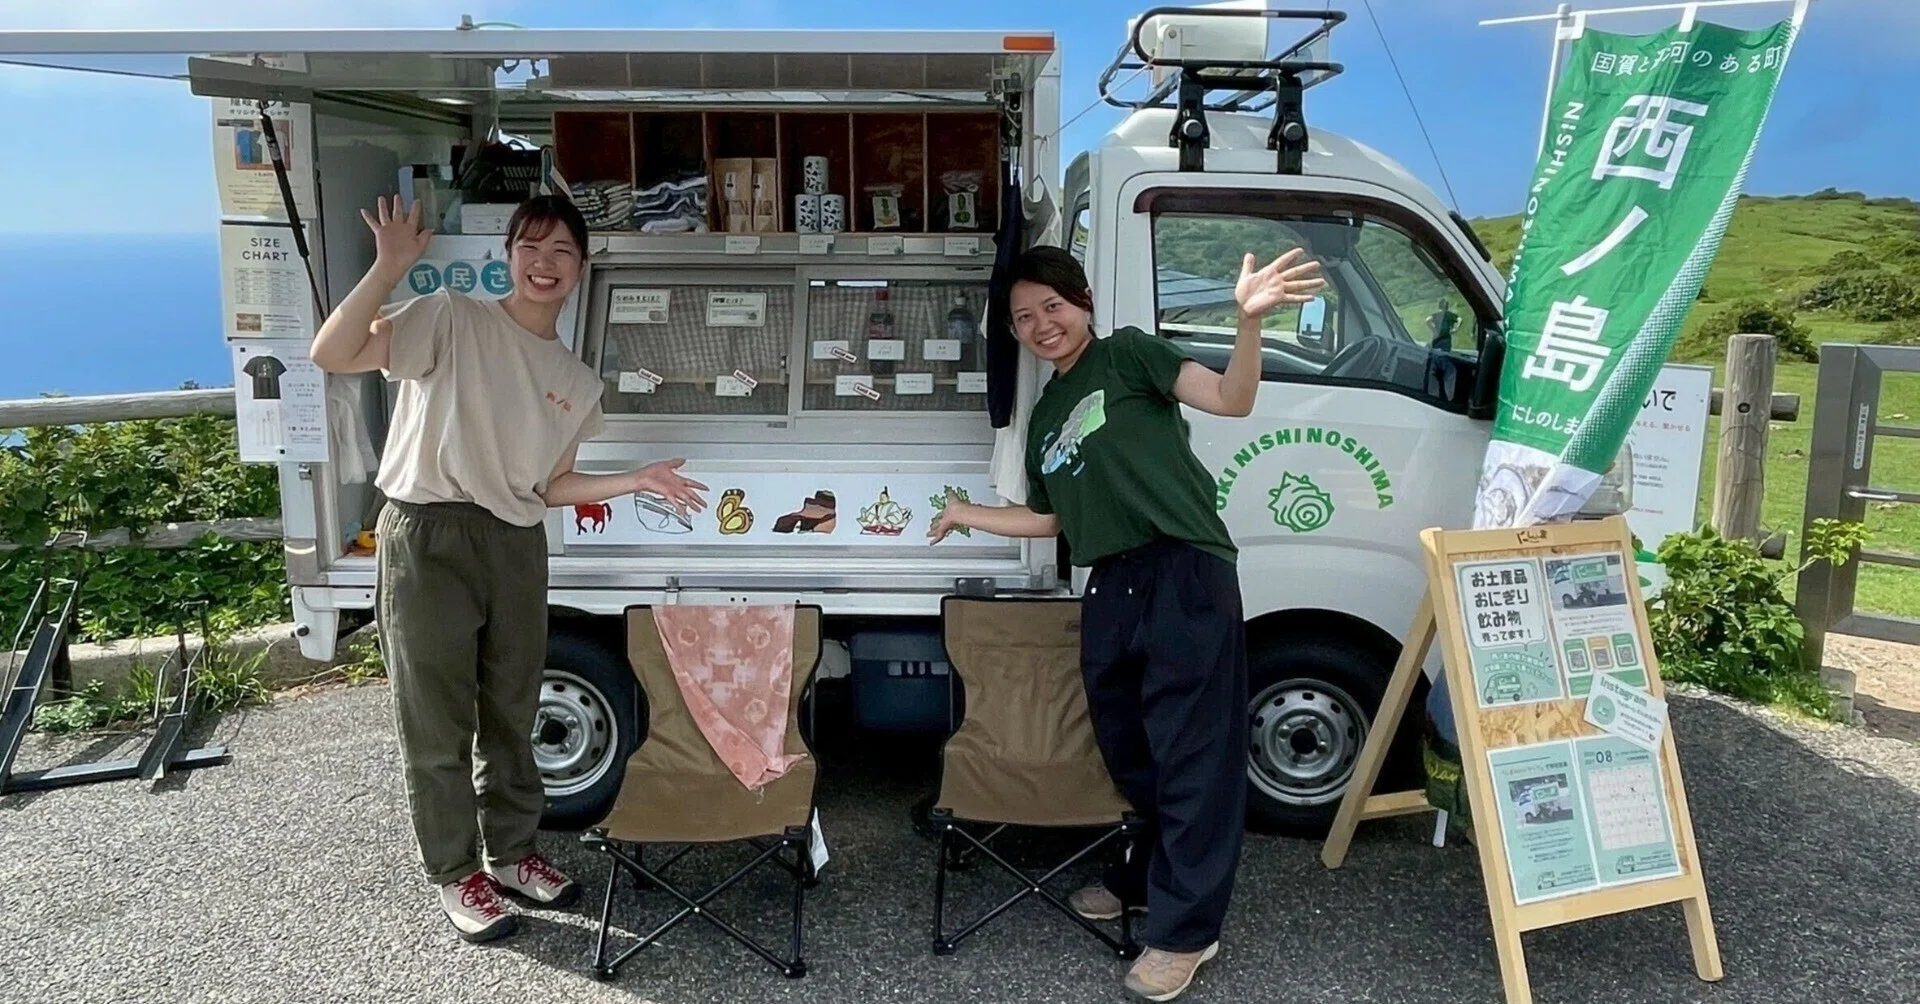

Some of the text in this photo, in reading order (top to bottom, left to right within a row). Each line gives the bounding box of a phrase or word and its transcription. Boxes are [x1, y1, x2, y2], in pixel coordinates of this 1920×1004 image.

[251, 238, 280, 248] SIZE
[1522, 93, 1708, 392] 西ノ島
[242, 251, 289, 261] CHART
[1216, 428, 1394, 511] OKI NISHINOSHIMA
[1471, 568, 1528, 588] お土産品
[1474, 589, 1530, 608] おにぎり
[1477, 610, 1523, 629] 飲み物
[1600, 676, 1648, 708] Instagram
[1595, 750, 1613, 763] 08
